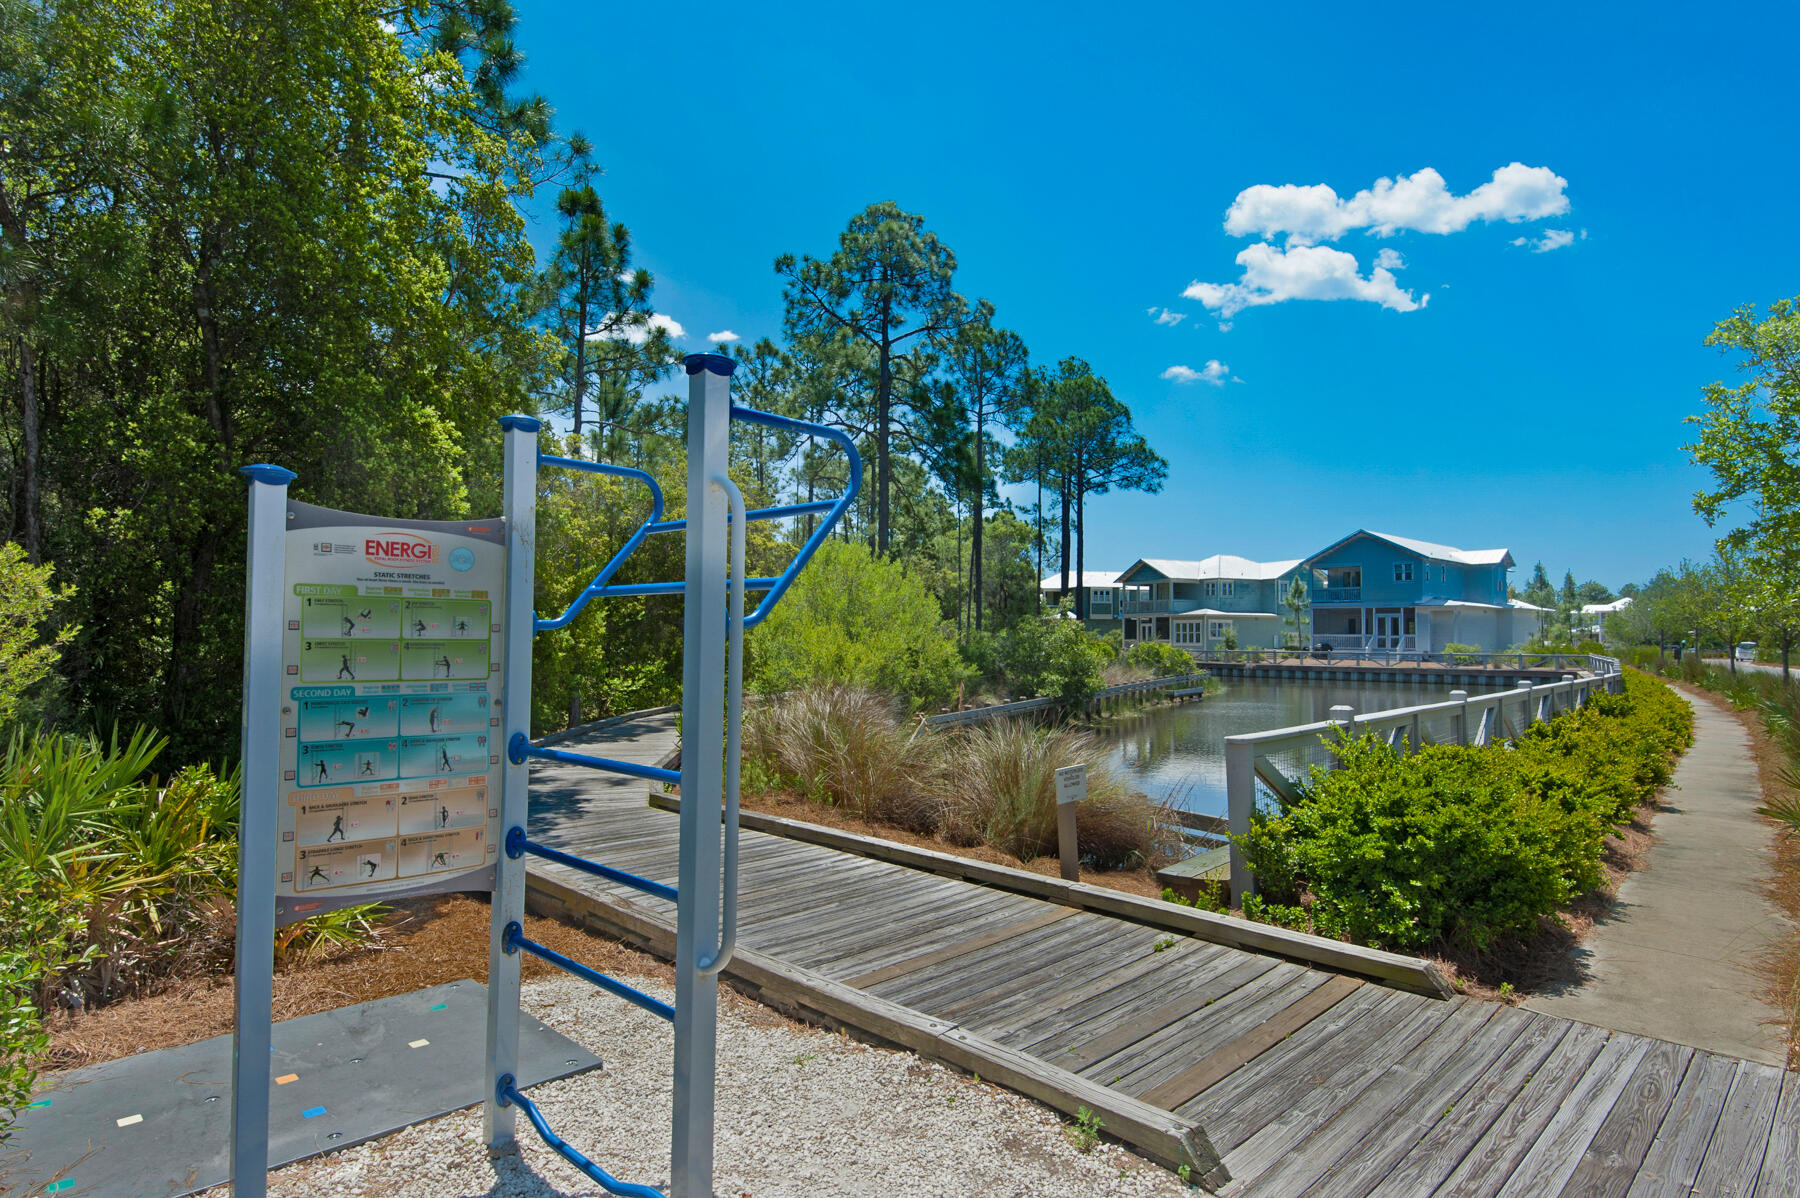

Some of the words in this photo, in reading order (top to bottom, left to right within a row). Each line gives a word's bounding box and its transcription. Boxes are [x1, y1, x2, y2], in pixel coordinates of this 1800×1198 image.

[365, 539, 431, 559] ENERGI
[397, 572, 431, 580] STRETCHES
[295, 585, 320, 594] FIRST
[323, 586, 343, 595] DAY
[306, 597, 312, 607] 1
[405, 601, 411, 609] 2
[305, 641, 312, 651] 3
[293, 688, 332, 698] SECOND
[333, 688, 352, 697] DAY
[303, 701, 309, 710] 1
[402, 698, 409, 707] 2
[401, 739, 408, 748] 4
[302, 745, 309, 754] 3
[401, 797, 408, 805] 2
[301, 805, 306, 815] 1
[400, 838, 407, 847] 4
[299, 850, 306, 860] 3
